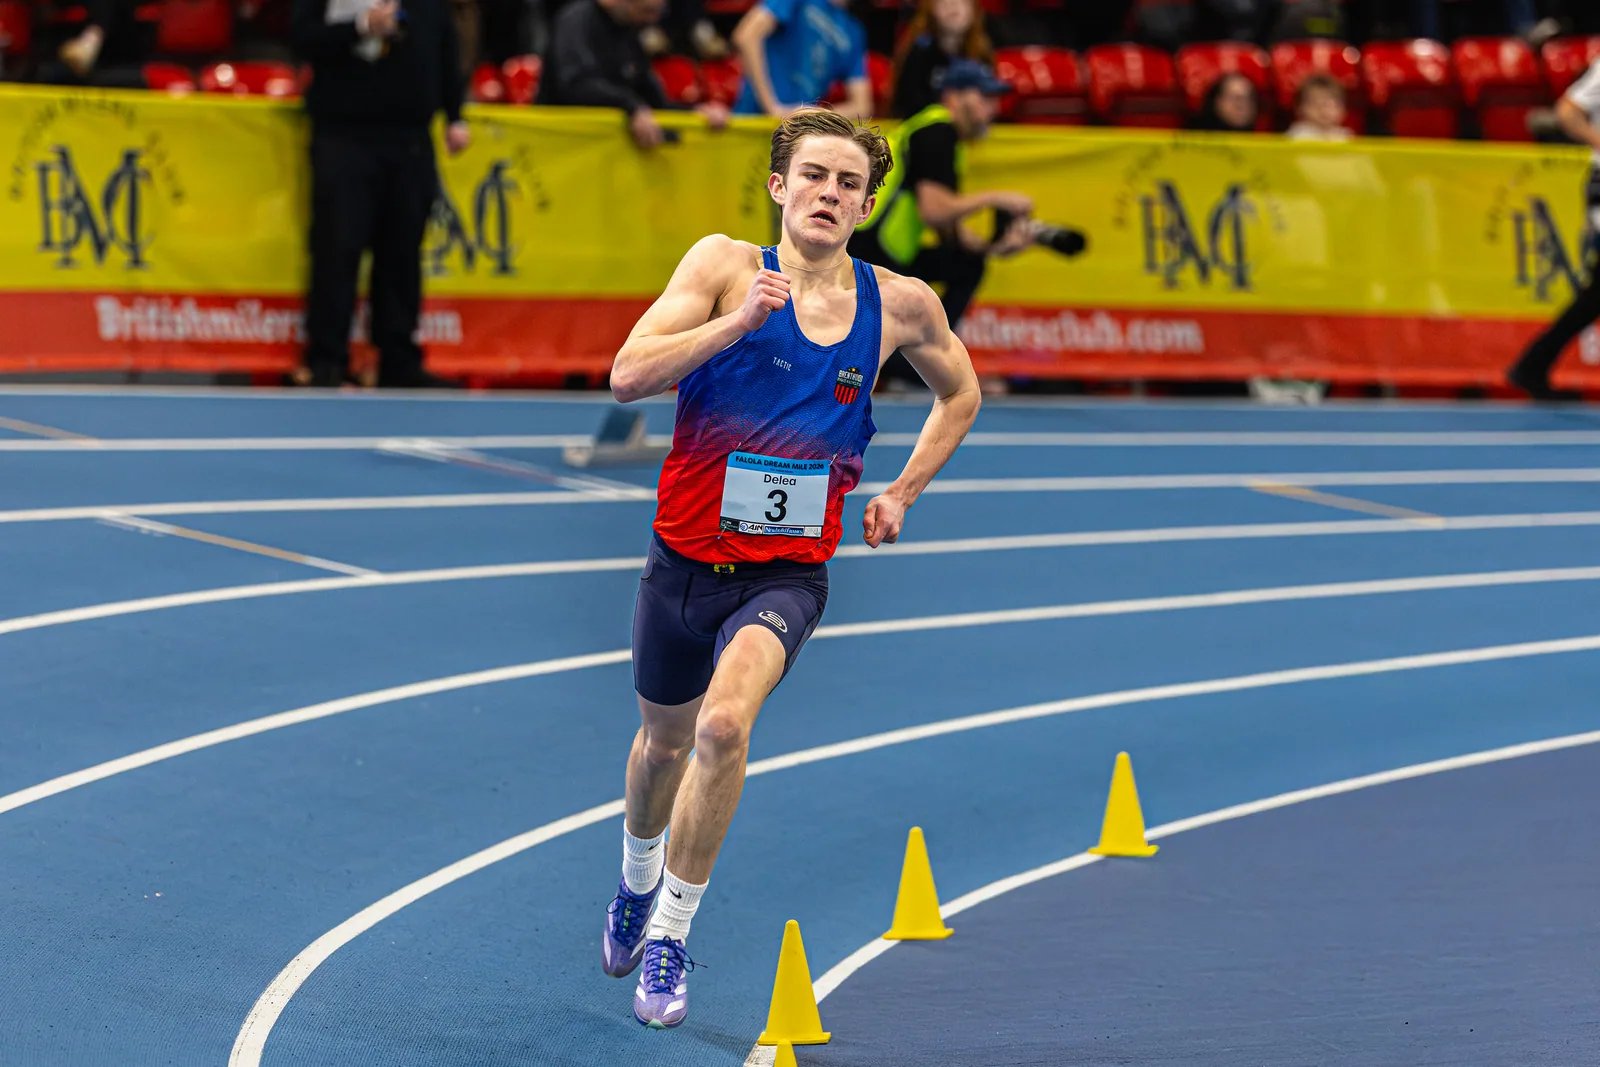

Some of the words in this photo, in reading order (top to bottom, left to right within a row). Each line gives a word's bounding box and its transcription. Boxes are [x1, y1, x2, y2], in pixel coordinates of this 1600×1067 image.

[772, 356, 792, 371] TACTIC
[735, 455, 763, 466] FALOLA
[763, 459, 791, 469] DREAM
[791, 463, 808, 471] MILE
[763, 474, 797, 486] Delea
[764, 489, 788, 523] 3
